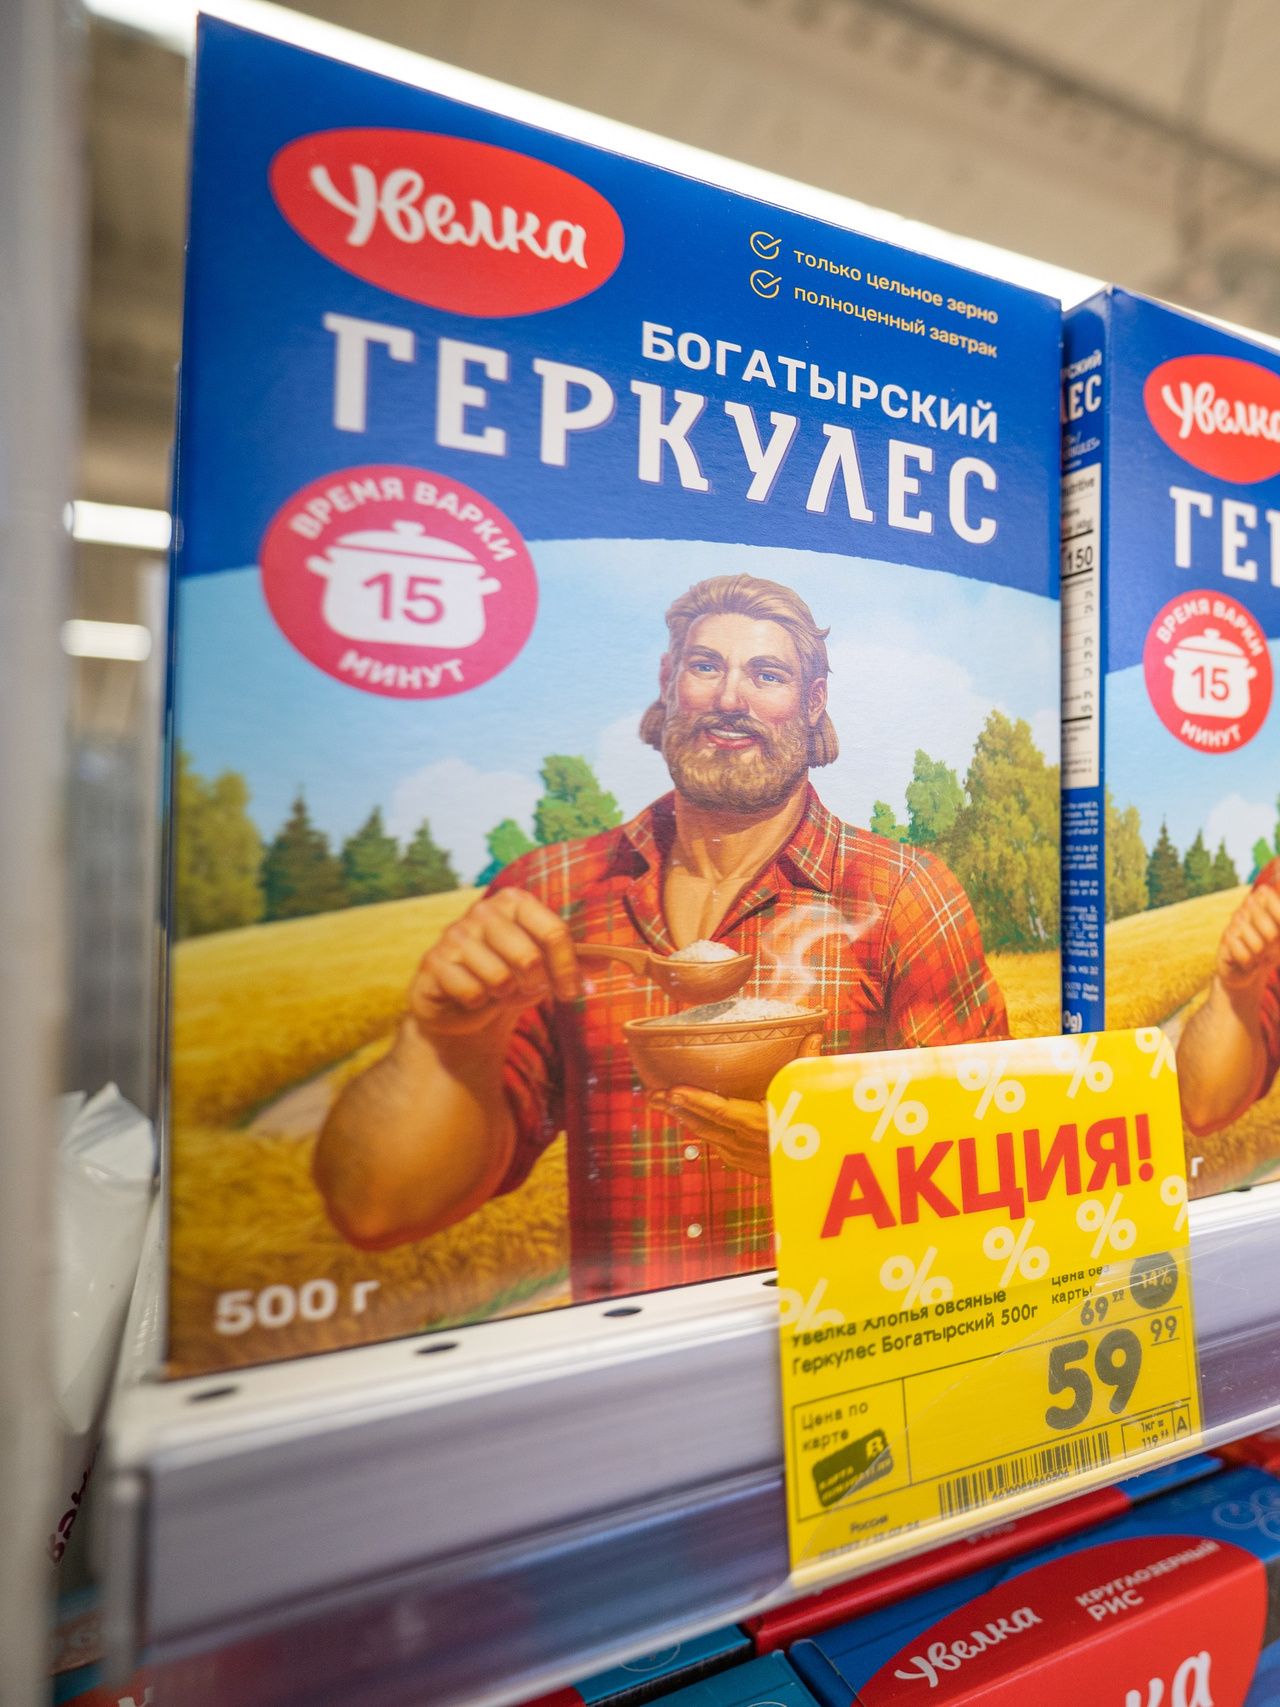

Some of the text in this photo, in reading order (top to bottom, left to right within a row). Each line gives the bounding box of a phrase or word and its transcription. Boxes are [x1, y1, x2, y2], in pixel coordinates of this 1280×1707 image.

[310, 164, 589, 270] Увелка
[793, 249, 999, 325] только цельное зерно
[794, 286, 998, 359] полноценный завтрак
[641, 321, 998, 444] БОГАТЫРСКИЙ
[324, 312, 999, 546] ГЕРКУЛЕС
[289, 476, 518, 563] ВРЕМЯ ВАРКИ
[1067, 545, 1094, 571] 150
[363, 571, 446, 626] 15
[1156, 597, 1265, 657] ВРЕМЯ ВАРКИ
[338, 649, 465, 690] МИНУТ
[1191, 664, 1230, 701] 15
[1180, 719, 1242, 748] МИНУТ
[820, 1113, 1155, 1239] АКЦИЯ!
[215, 1278, 339, 1336] 500
[862, 1306, 929, 1332] Хлопья
[1080, 1296, 1109, 1326] 69
[792, 1303, 1038, 1376] Геркулес Богатырский 500г
[1045, 1315, 1178, 1430] 59 99
[802, 1401, 869, 1431] Цена по
[802, 1429, 850, 1452] карте
[1075, 1539, 1221, 1607] КРУГЛОЗЕРНЫЙ
[1087, 1588, 1145, 1621] РИС
[894, 1606, 1043, 1688] Увелка
